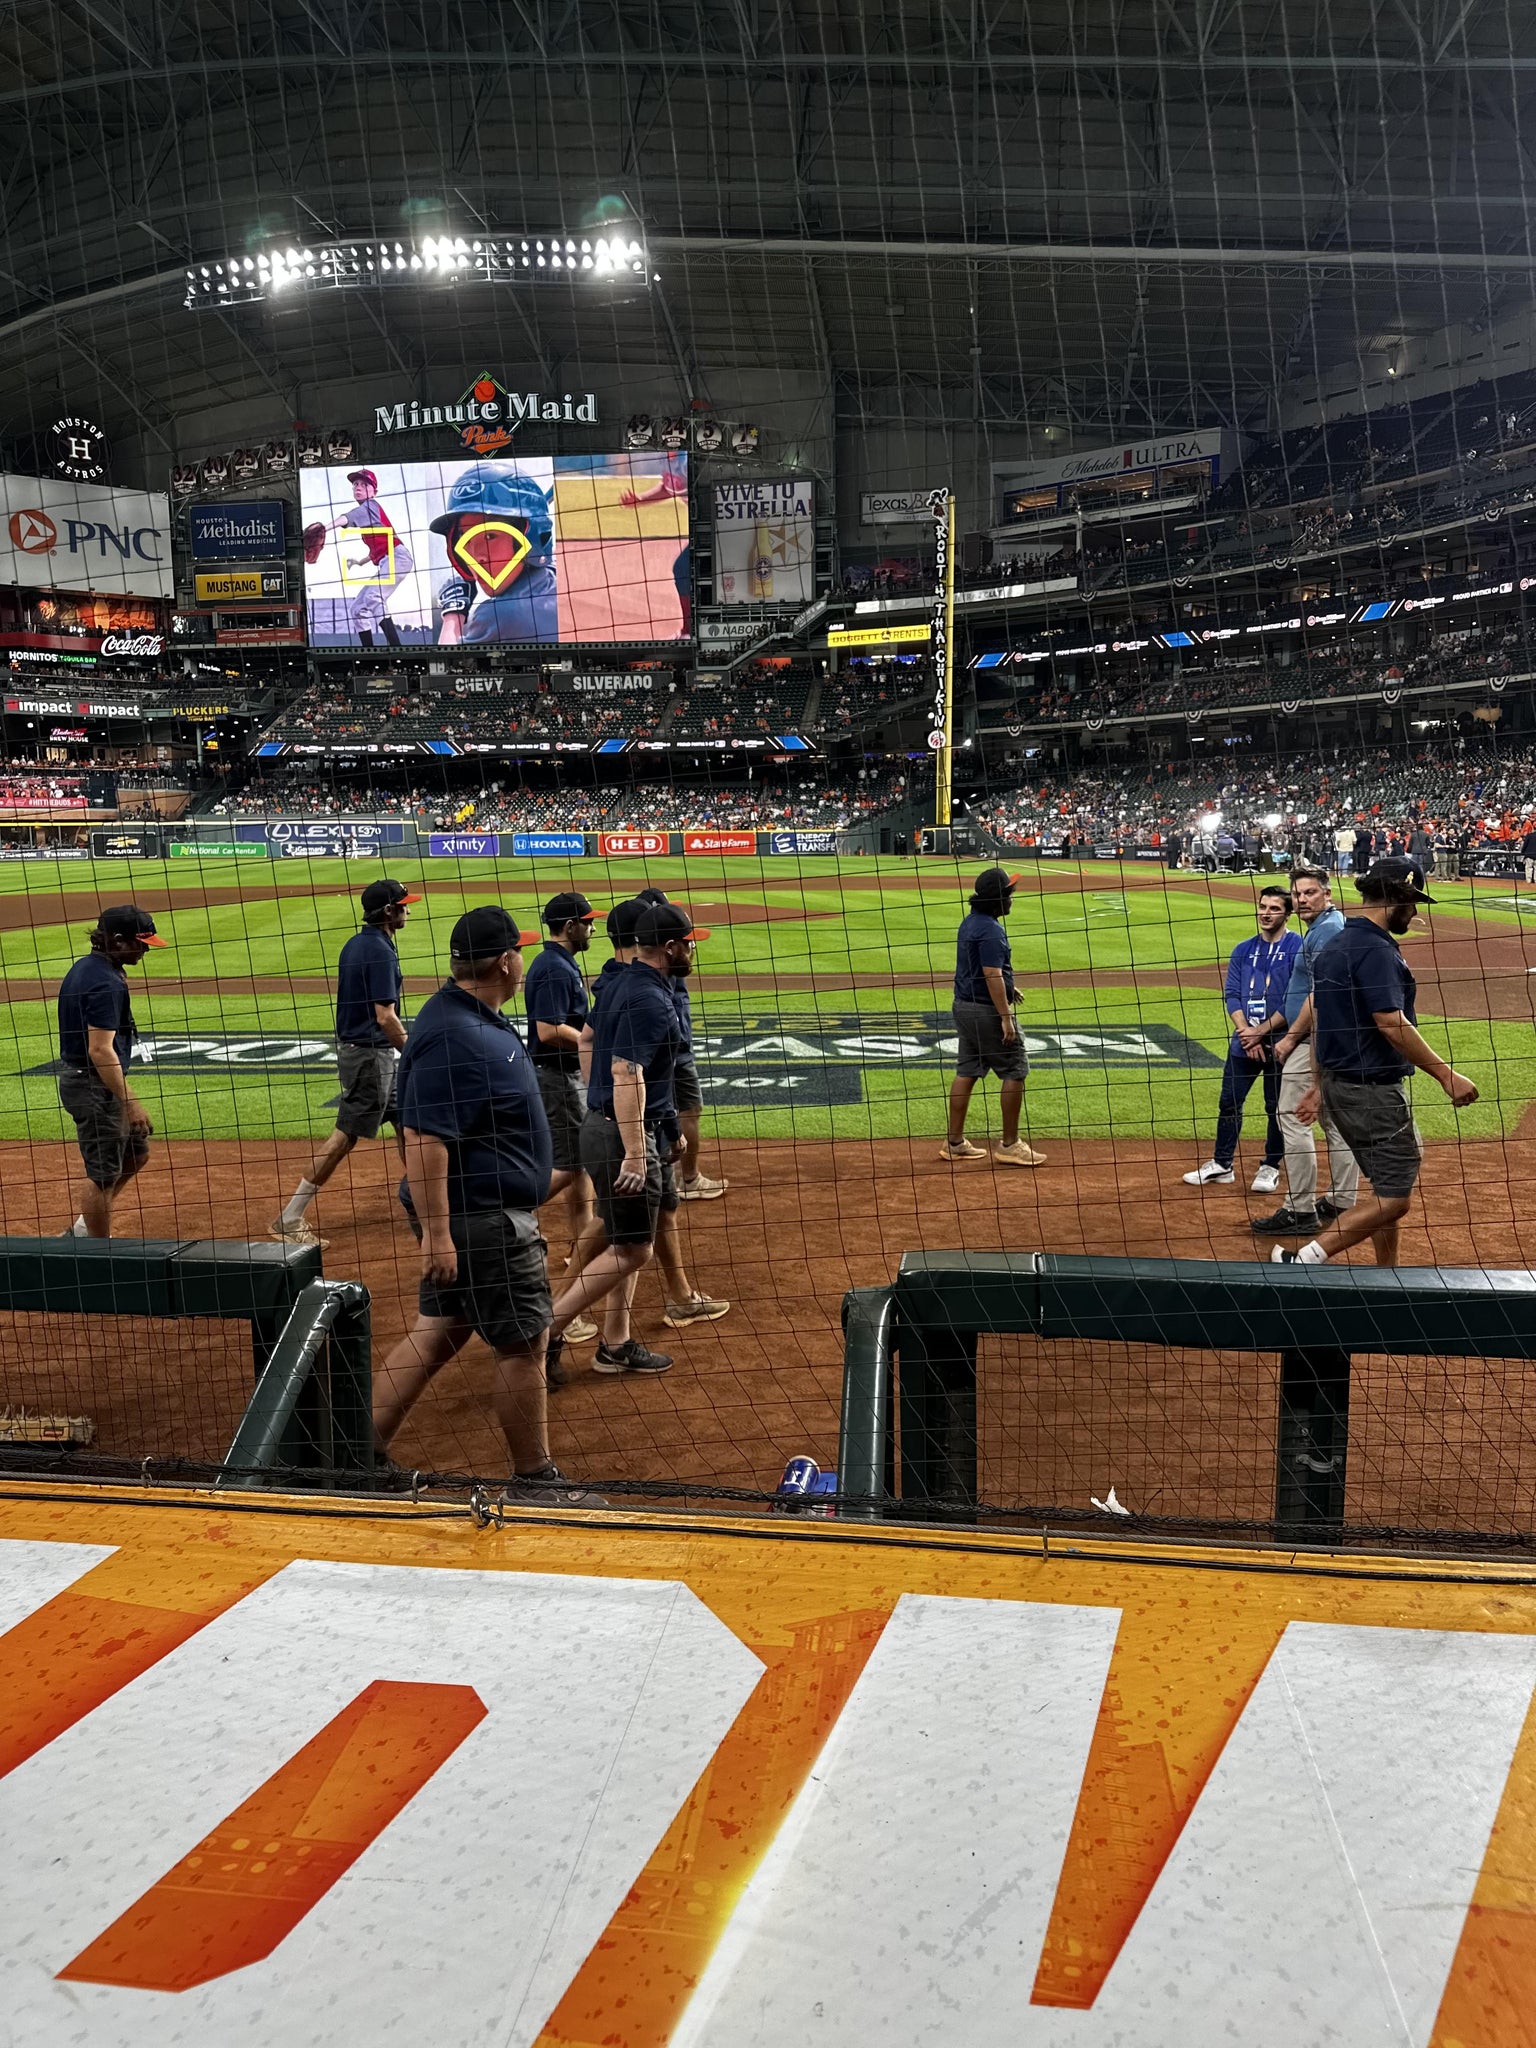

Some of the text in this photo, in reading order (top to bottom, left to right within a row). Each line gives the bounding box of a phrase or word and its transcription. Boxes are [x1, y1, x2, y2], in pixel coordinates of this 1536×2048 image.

[374, 392, 598, 435] Minute Maid
[52, 418, 104, 440] HOUSTON
[627, 414, 650, 433] 49
[661, 416, 685, 435] 24
[460, 425, 512, 453] Park
[68, 437, 92, 460] H
[1061, 440, 1203, 479] Michelob ULTRA
[57, 460, 103, 479] ASTROS
[771, 482, 795, 500] TU
[866, 495, 908, 512] Texas
[197, 519, 276, 539] Methodist
[62, 519, 163, 561] PNC
[935, 525, 947, 577] ROOT
[206, 578, 282, 593] MUSTANG CAT
[935, 603, 946, 644] THA
[832, 629, 924, 643] DOGGETT RENTS
[101, 635, 165, 657] Coca-Cola
[9, 651, 58, 662] HORNITOS
[455, 675, 653, 693] CHEVY SILVERADO
[19, 701, 73, 714] impact
[89, 704, 140, 717] impact
[173, 706, 229, 716] PLUCKERS
[294, 825, 373, 838] LEXUS
[363, 827, 382, 836] 370
[796, 833, 831, 842] ENERGY
[189, 846, 257, 856] National Car Rental
[442, 836, 486, 853] xfinity
[528, 840, 583, 849] HONDA
[704, 838, 750, 848] State Farm
